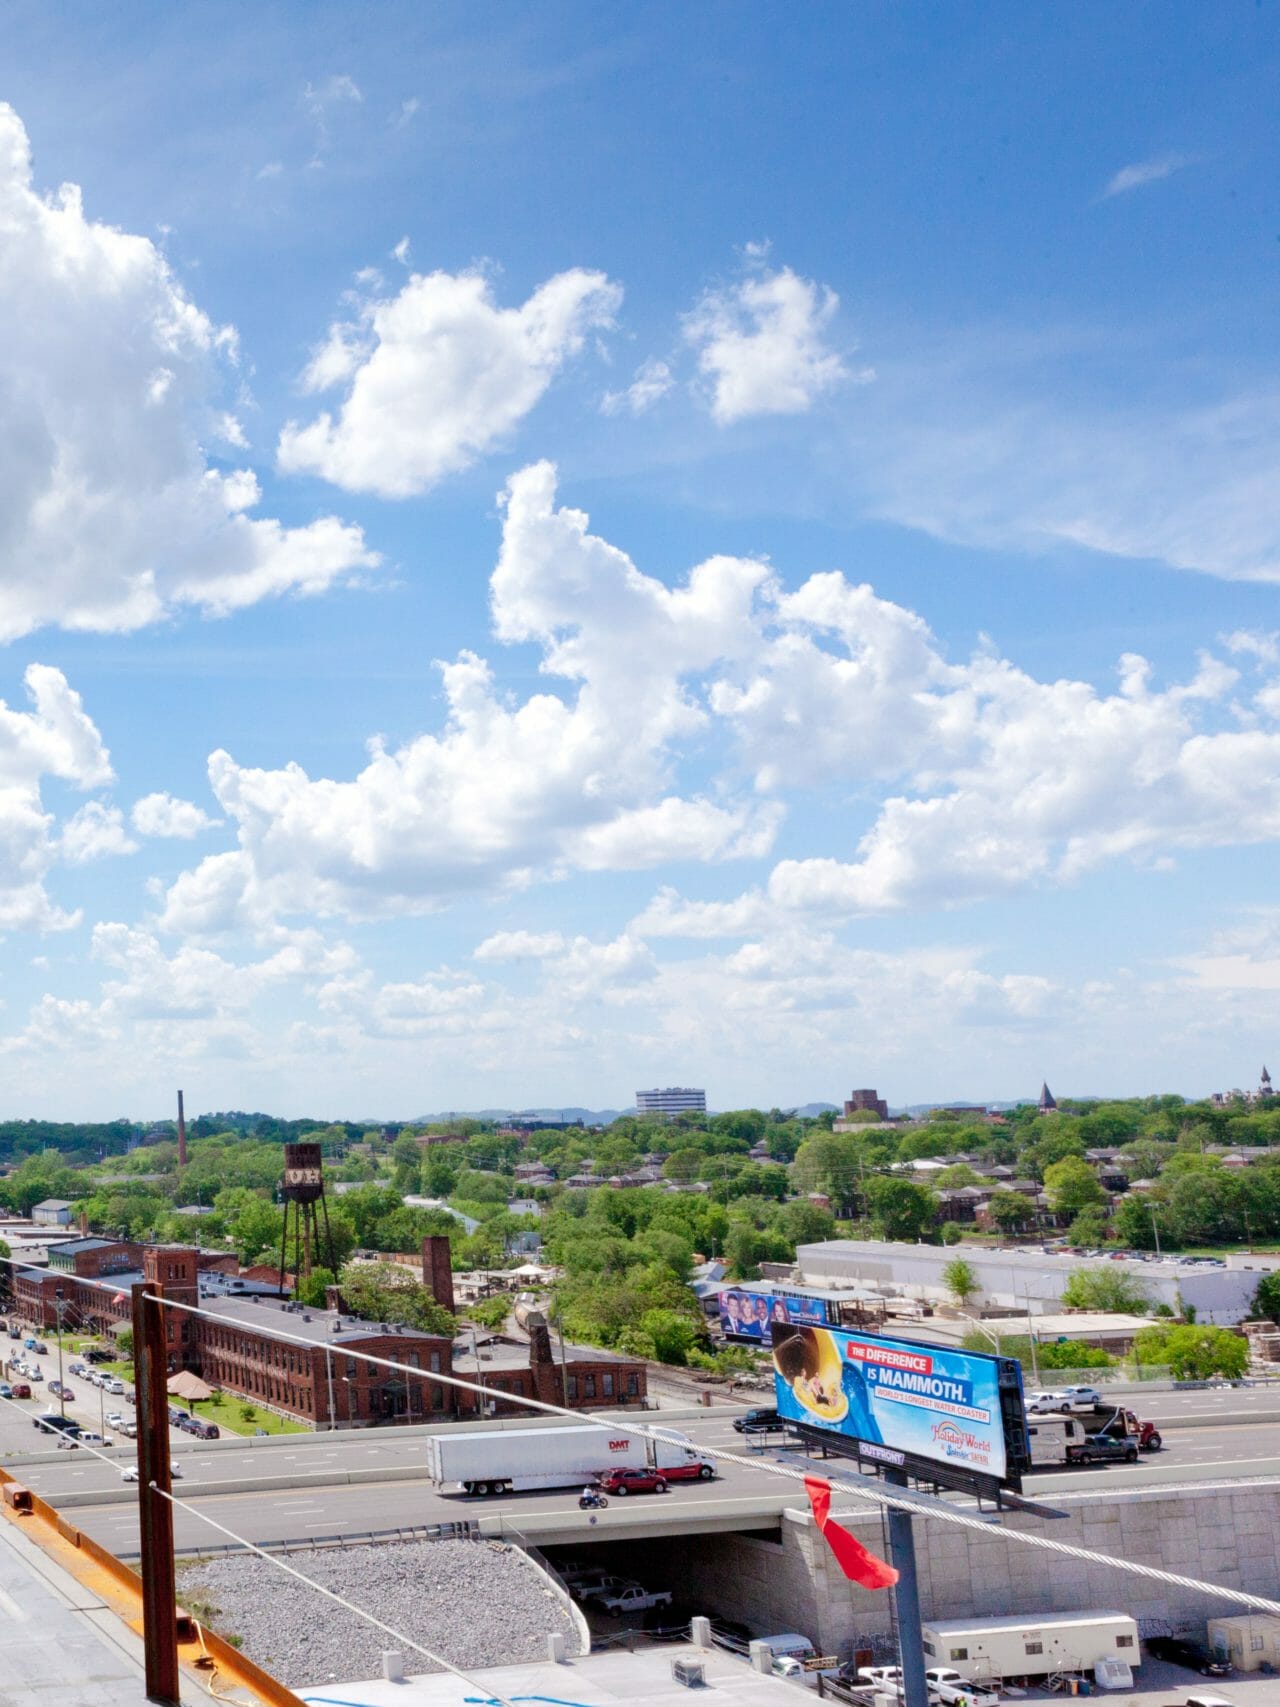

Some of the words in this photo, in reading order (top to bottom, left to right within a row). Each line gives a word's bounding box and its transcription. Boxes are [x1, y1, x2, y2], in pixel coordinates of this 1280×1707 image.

[852, 1346, 865, 1357] THE
[866, 1348, 926, 1371] DIFFERENCE
[867, 1368, 877, 1380] IS
[879, 1368, 967, 1402] MAMMOTH.
[905, 1394, 932, 1406] LONGEST
[934, 1400, 957, 1412] WATER
[957, 1407, 987, 1420] COASTER
[608, 1440, 630, 1450] DMT
[931, 1424, 963, 1449] Holiday
[962, 1433, 991, 1452] World
[861, 1443, 903, 1463] OUTFRONT
